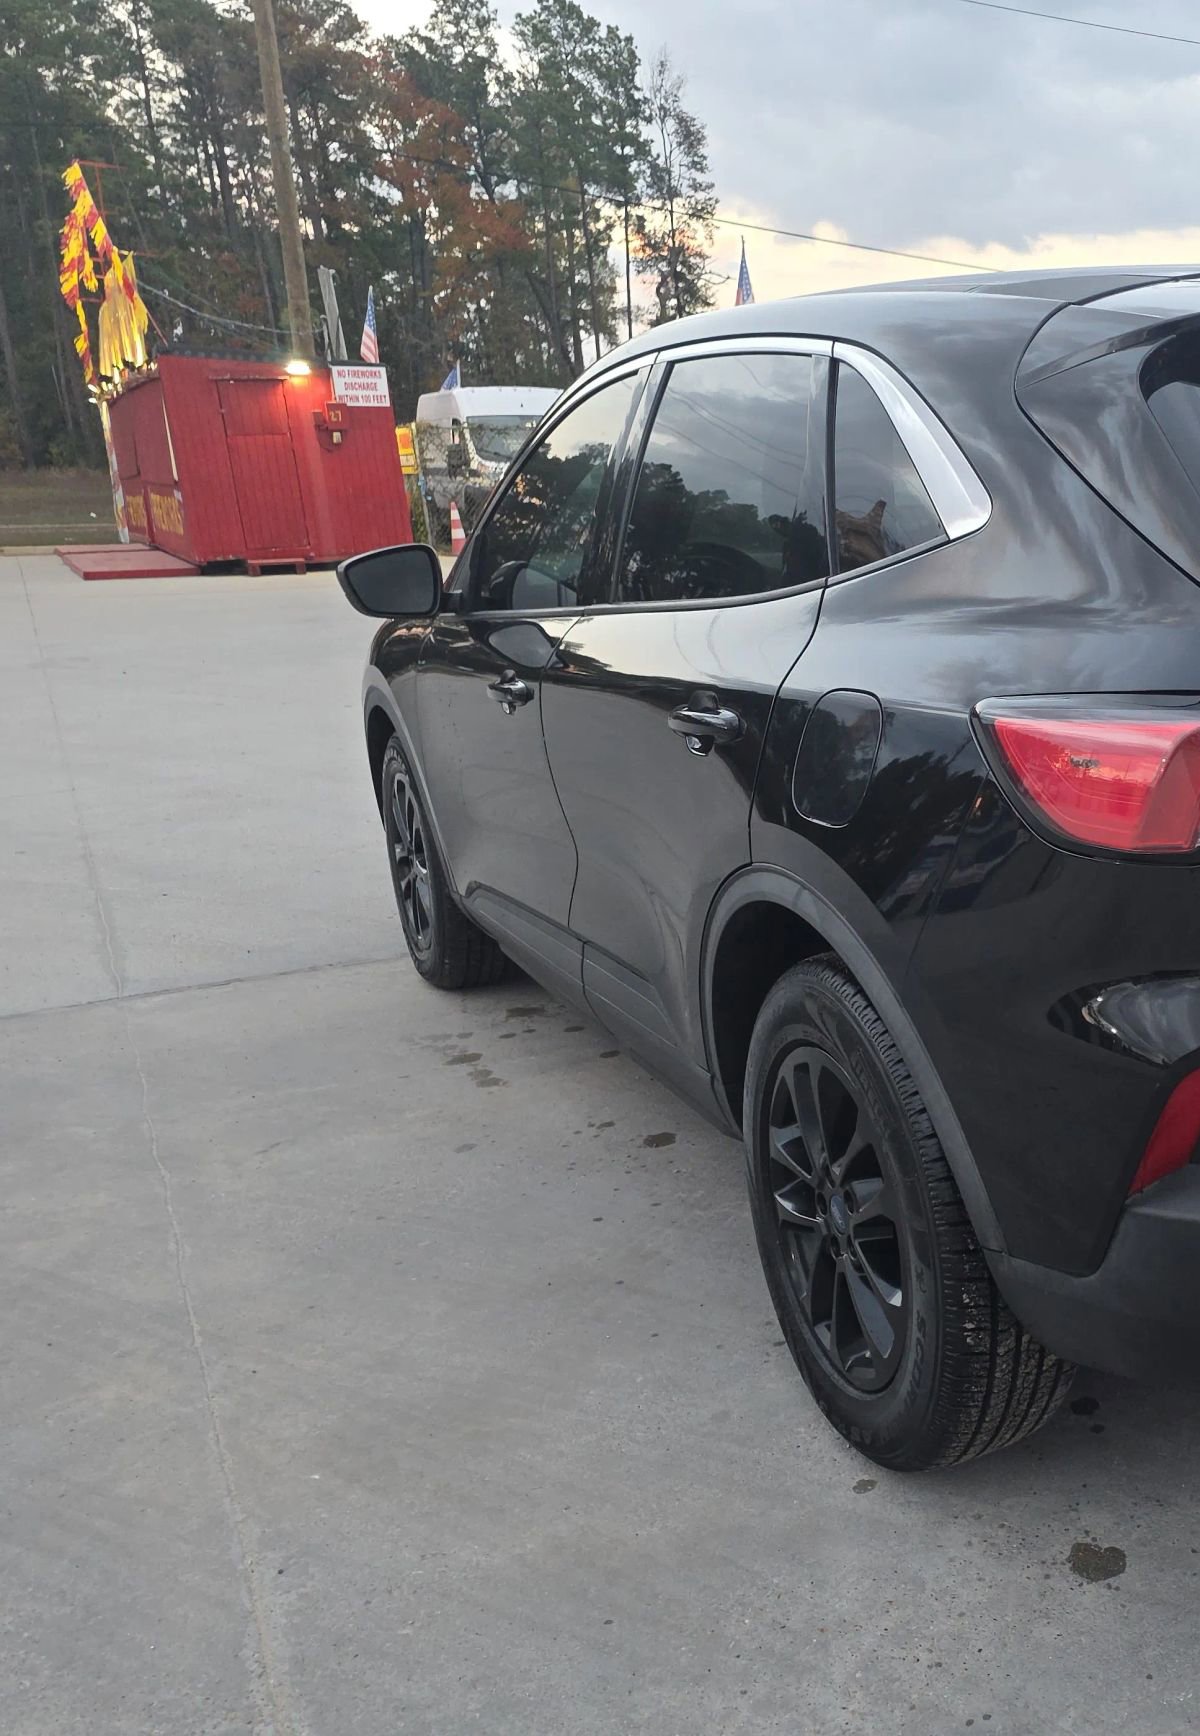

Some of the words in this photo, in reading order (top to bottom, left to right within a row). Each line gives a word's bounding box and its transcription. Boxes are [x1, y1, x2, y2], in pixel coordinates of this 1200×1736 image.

[336, 369, 346, 378] NO
[347, 369, 382, 379] FIREWORKS
[344, 381, 378, 391] DISCHARGE
[372, 394, 387, 404] FEET
